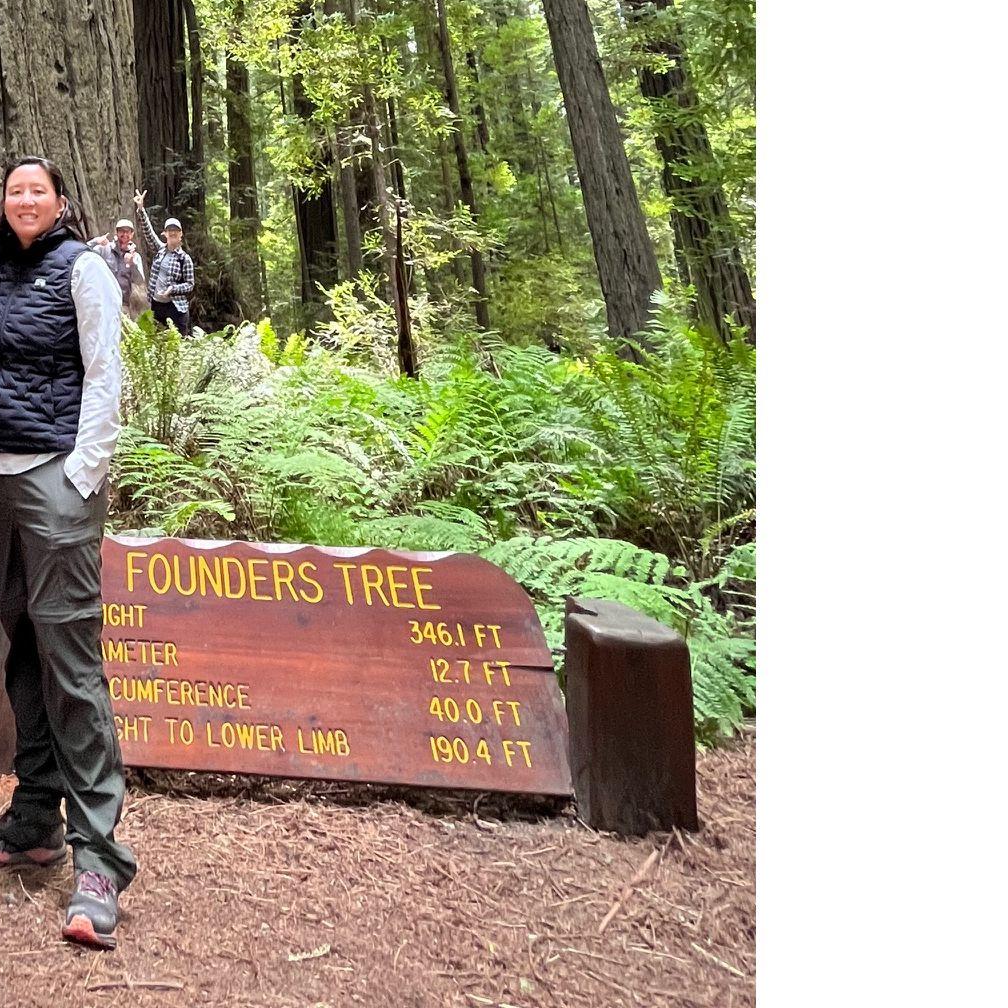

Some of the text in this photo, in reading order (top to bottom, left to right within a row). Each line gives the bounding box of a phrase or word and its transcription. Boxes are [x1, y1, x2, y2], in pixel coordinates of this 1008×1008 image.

[126, 551, 442, 610] FOUNDERS TREE
[102, 603, 148, 628] IGHT
[408, 620, 501, 649] 346.1 FT
[101, 639, 179, 667] METER
[430, 658, 511, 687] 12.7 FT
[109, 676, 252, 710] CUMFERENCE
[429, 696, 521, 727] 40.0 FT
[113, 715, 351, 756] GHT TO LOWER LIMB
[430, 736, 532, 768] 190.4 FT
